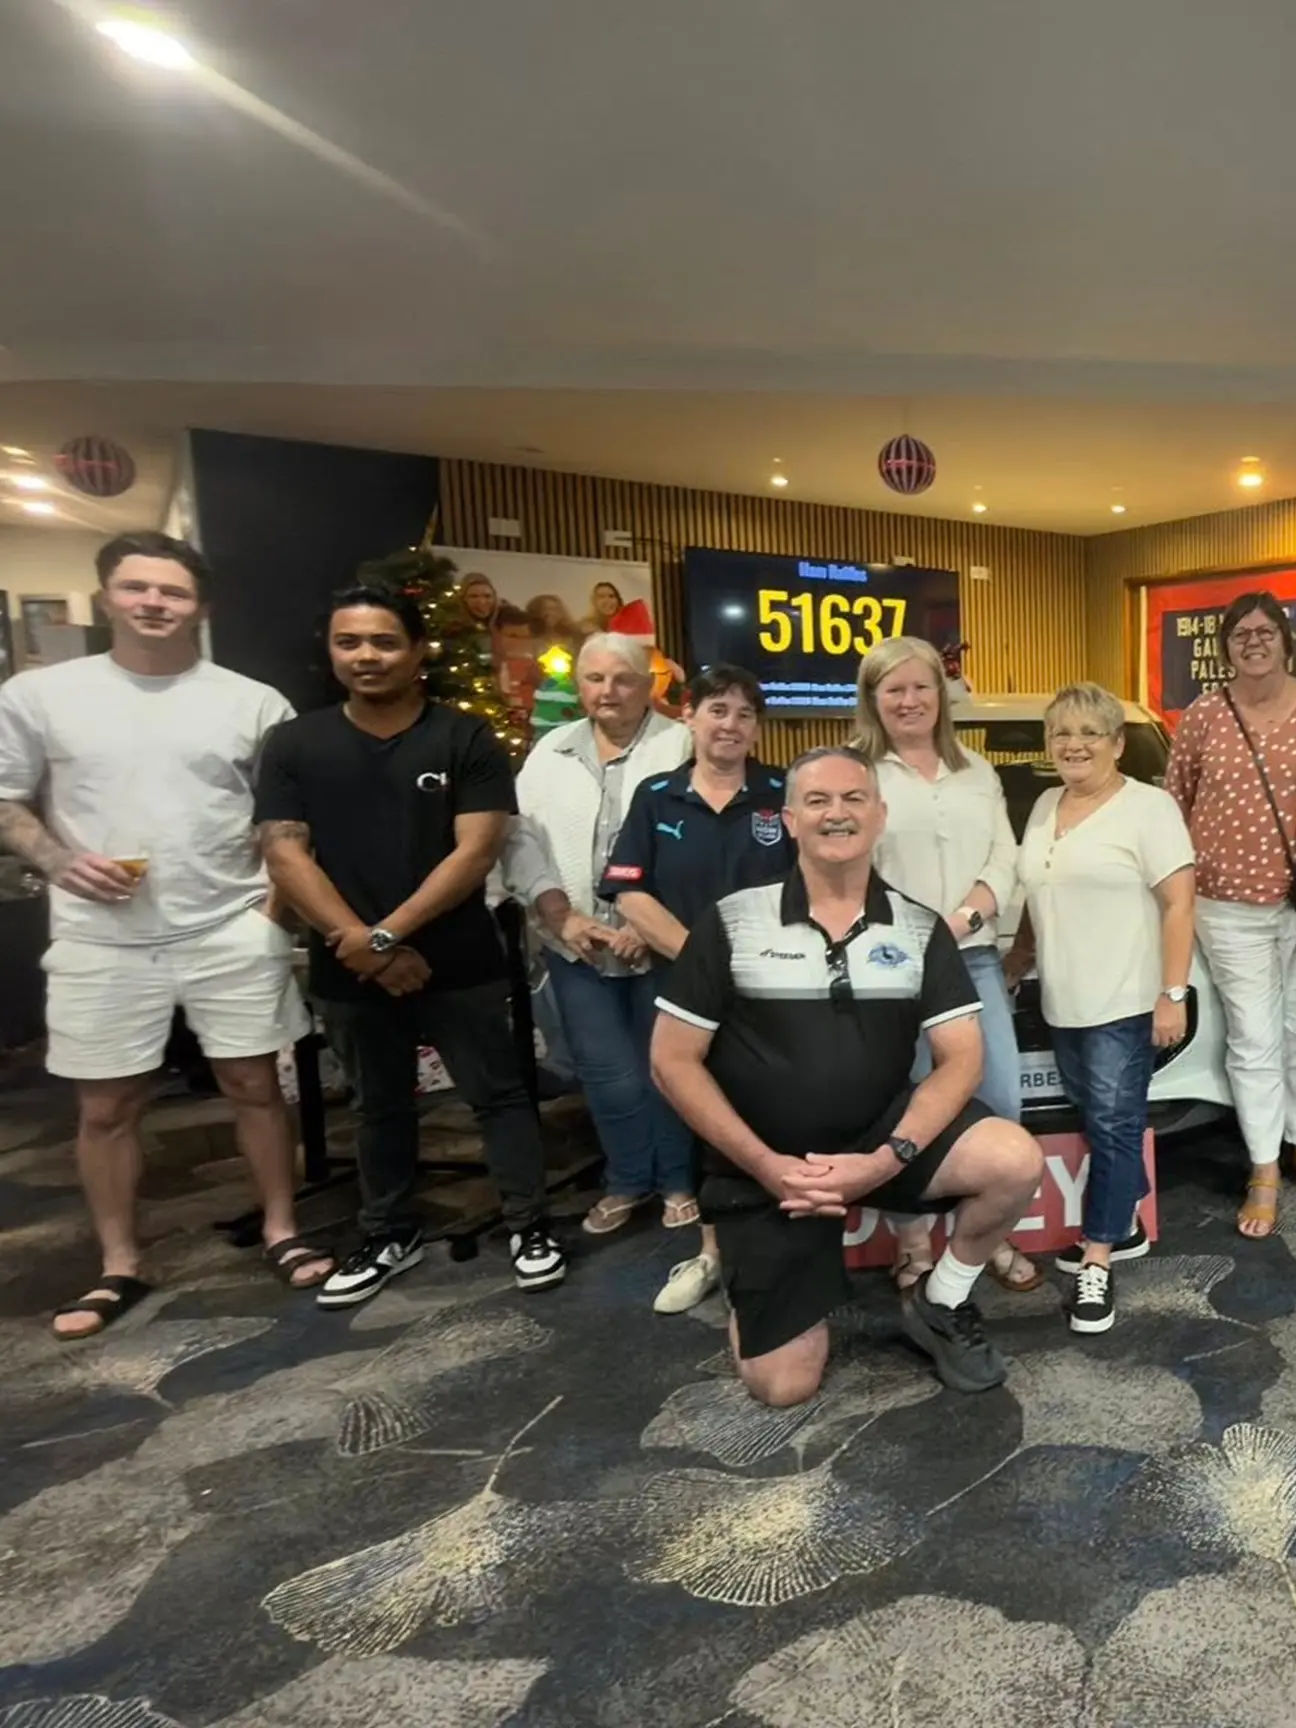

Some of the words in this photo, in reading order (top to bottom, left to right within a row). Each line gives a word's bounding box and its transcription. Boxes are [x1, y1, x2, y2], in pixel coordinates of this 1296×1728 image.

[758, 588, 907, 656] 51637
[1190, 660, 1237, 680] PALES
[1019, 1070, 1063, 1089] RBE
